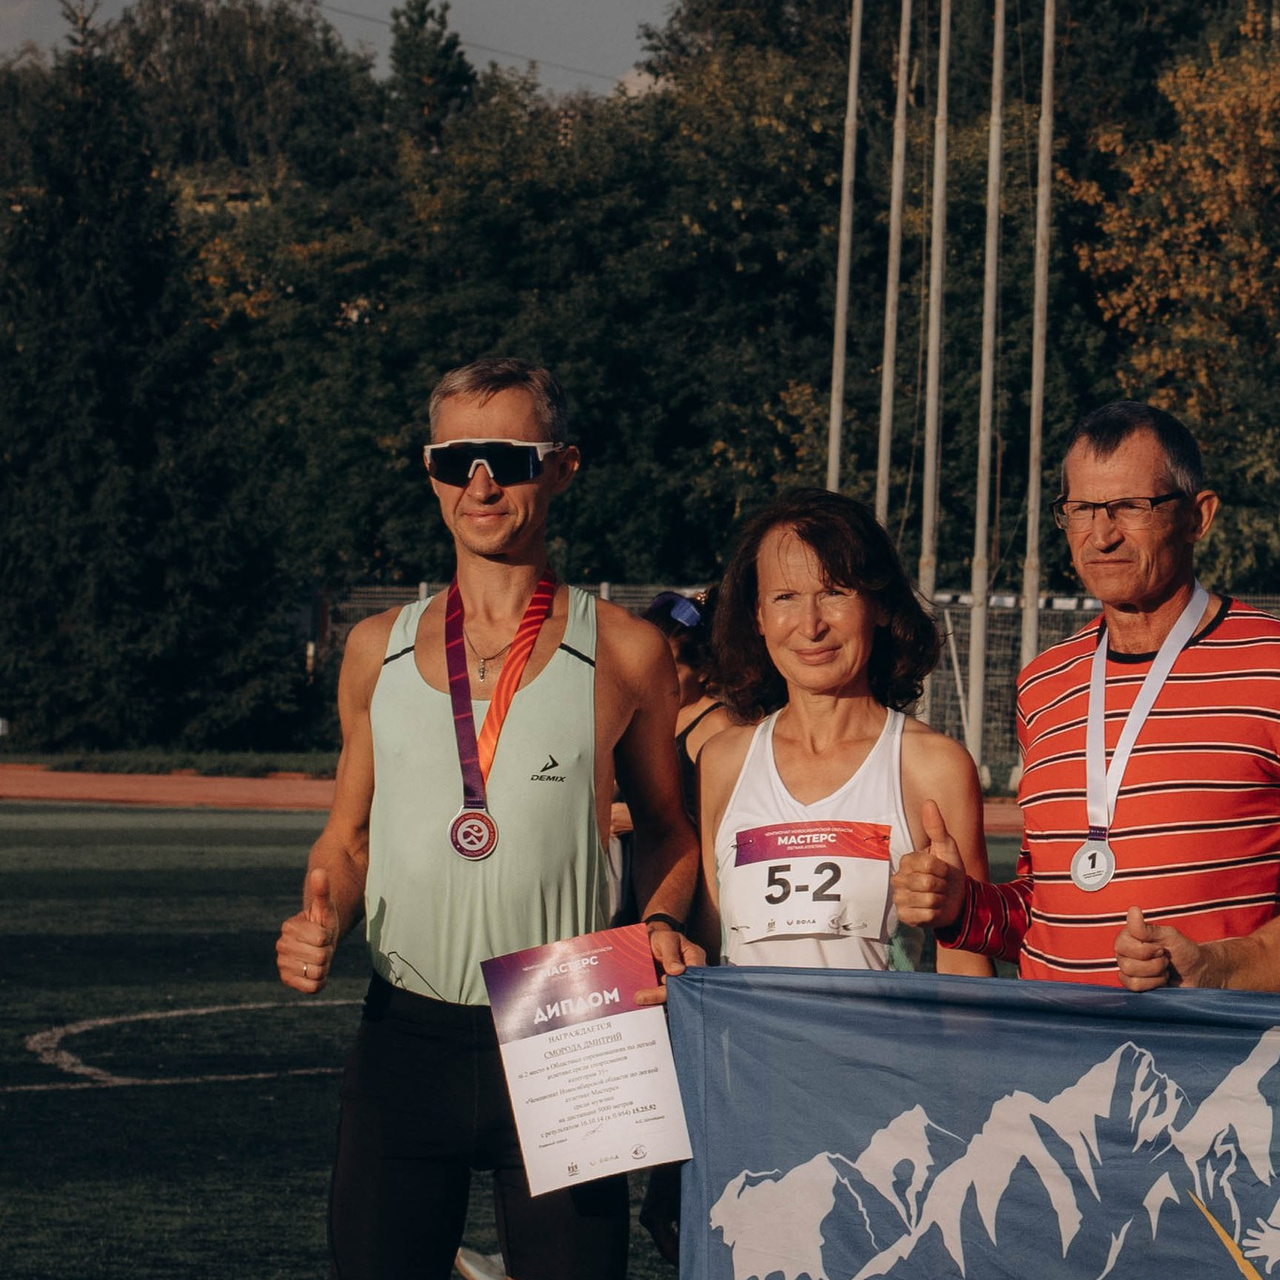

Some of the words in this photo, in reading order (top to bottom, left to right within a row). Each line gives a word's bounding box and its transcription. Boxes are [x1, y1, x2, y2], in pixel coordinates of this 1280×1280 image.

[530, 774, 566, 783] DEMIX
[777, 833, 837, 846] МАСТЕРС
[1087, 852, 1097, 869] 1
[765, 861, 842, 905] 5-2
[534, 988, 620, 1025] ДИПЛОМ
[548, 1022, 612, 1043] НАГРАЖДАЕТСЯ
[543, 1044, 582, 1060] СМОРОДА
[583, 1032, 623, 1049] ДМИТРИЙ
